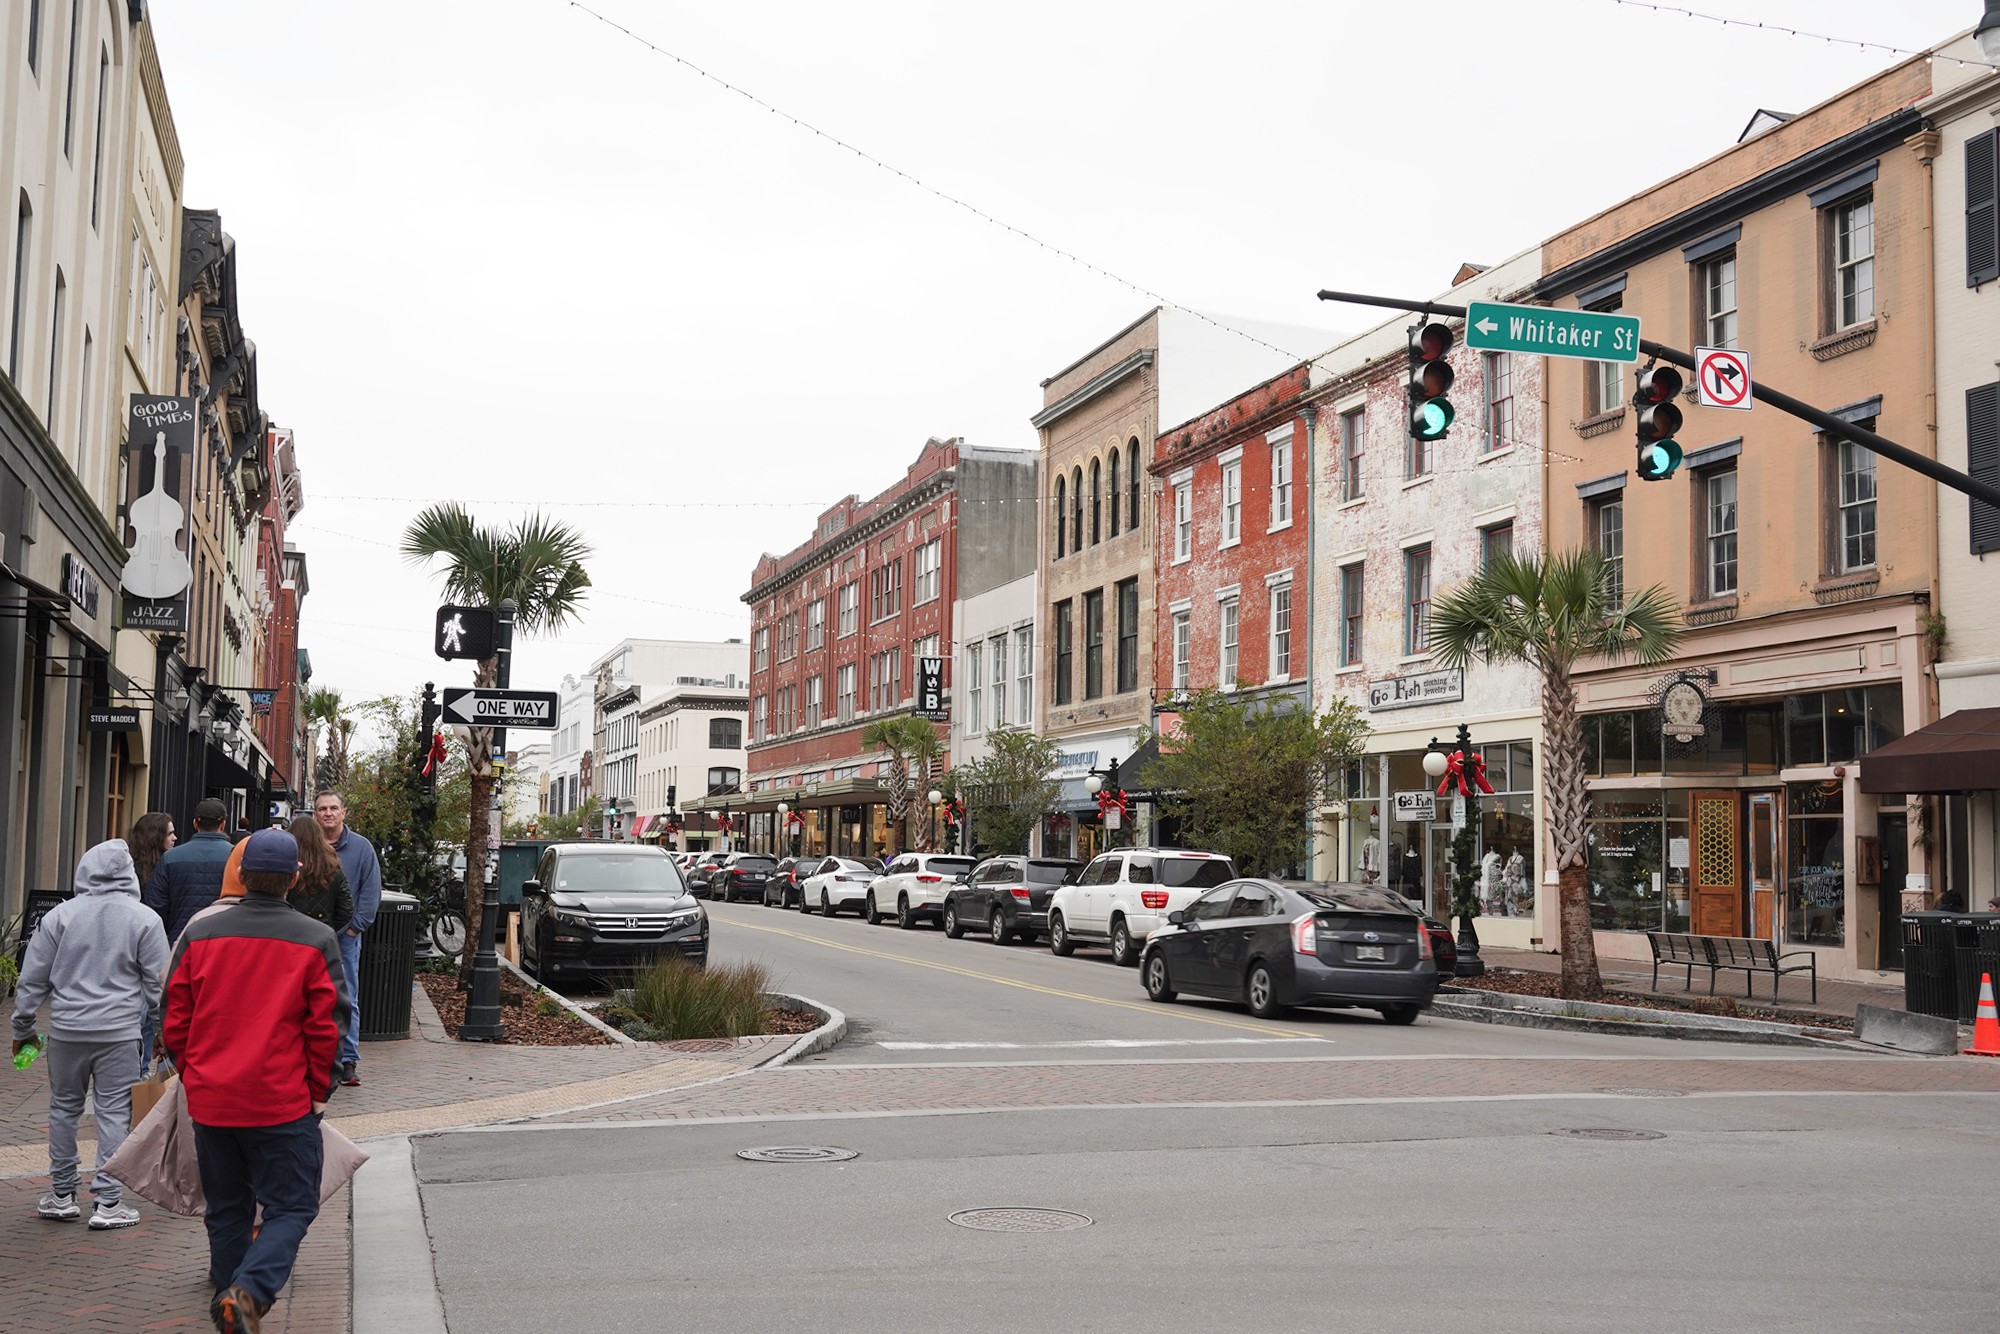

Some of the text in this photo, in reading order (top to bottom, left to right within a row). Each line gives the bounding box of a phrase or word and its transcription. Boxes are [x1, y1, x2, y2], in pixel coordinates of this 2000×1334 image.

[1509, 316, 1633, 351] Whitaker St
[132, 400, 179, 417] GOOD
[142, 410, 192, 428] TIMES
[132, 606, 174, 618] JAZZ
[1424, 678, 1447, 687] clothing
[1371, 678, 1420, 706] Go Fish
[1424, 686, 1446, 696] jewelry
[253, 694, 270, 703] VICE
[477, 700, 544, 716] ONE WAY
[1398, 794, 1432, 807] Go Fish
